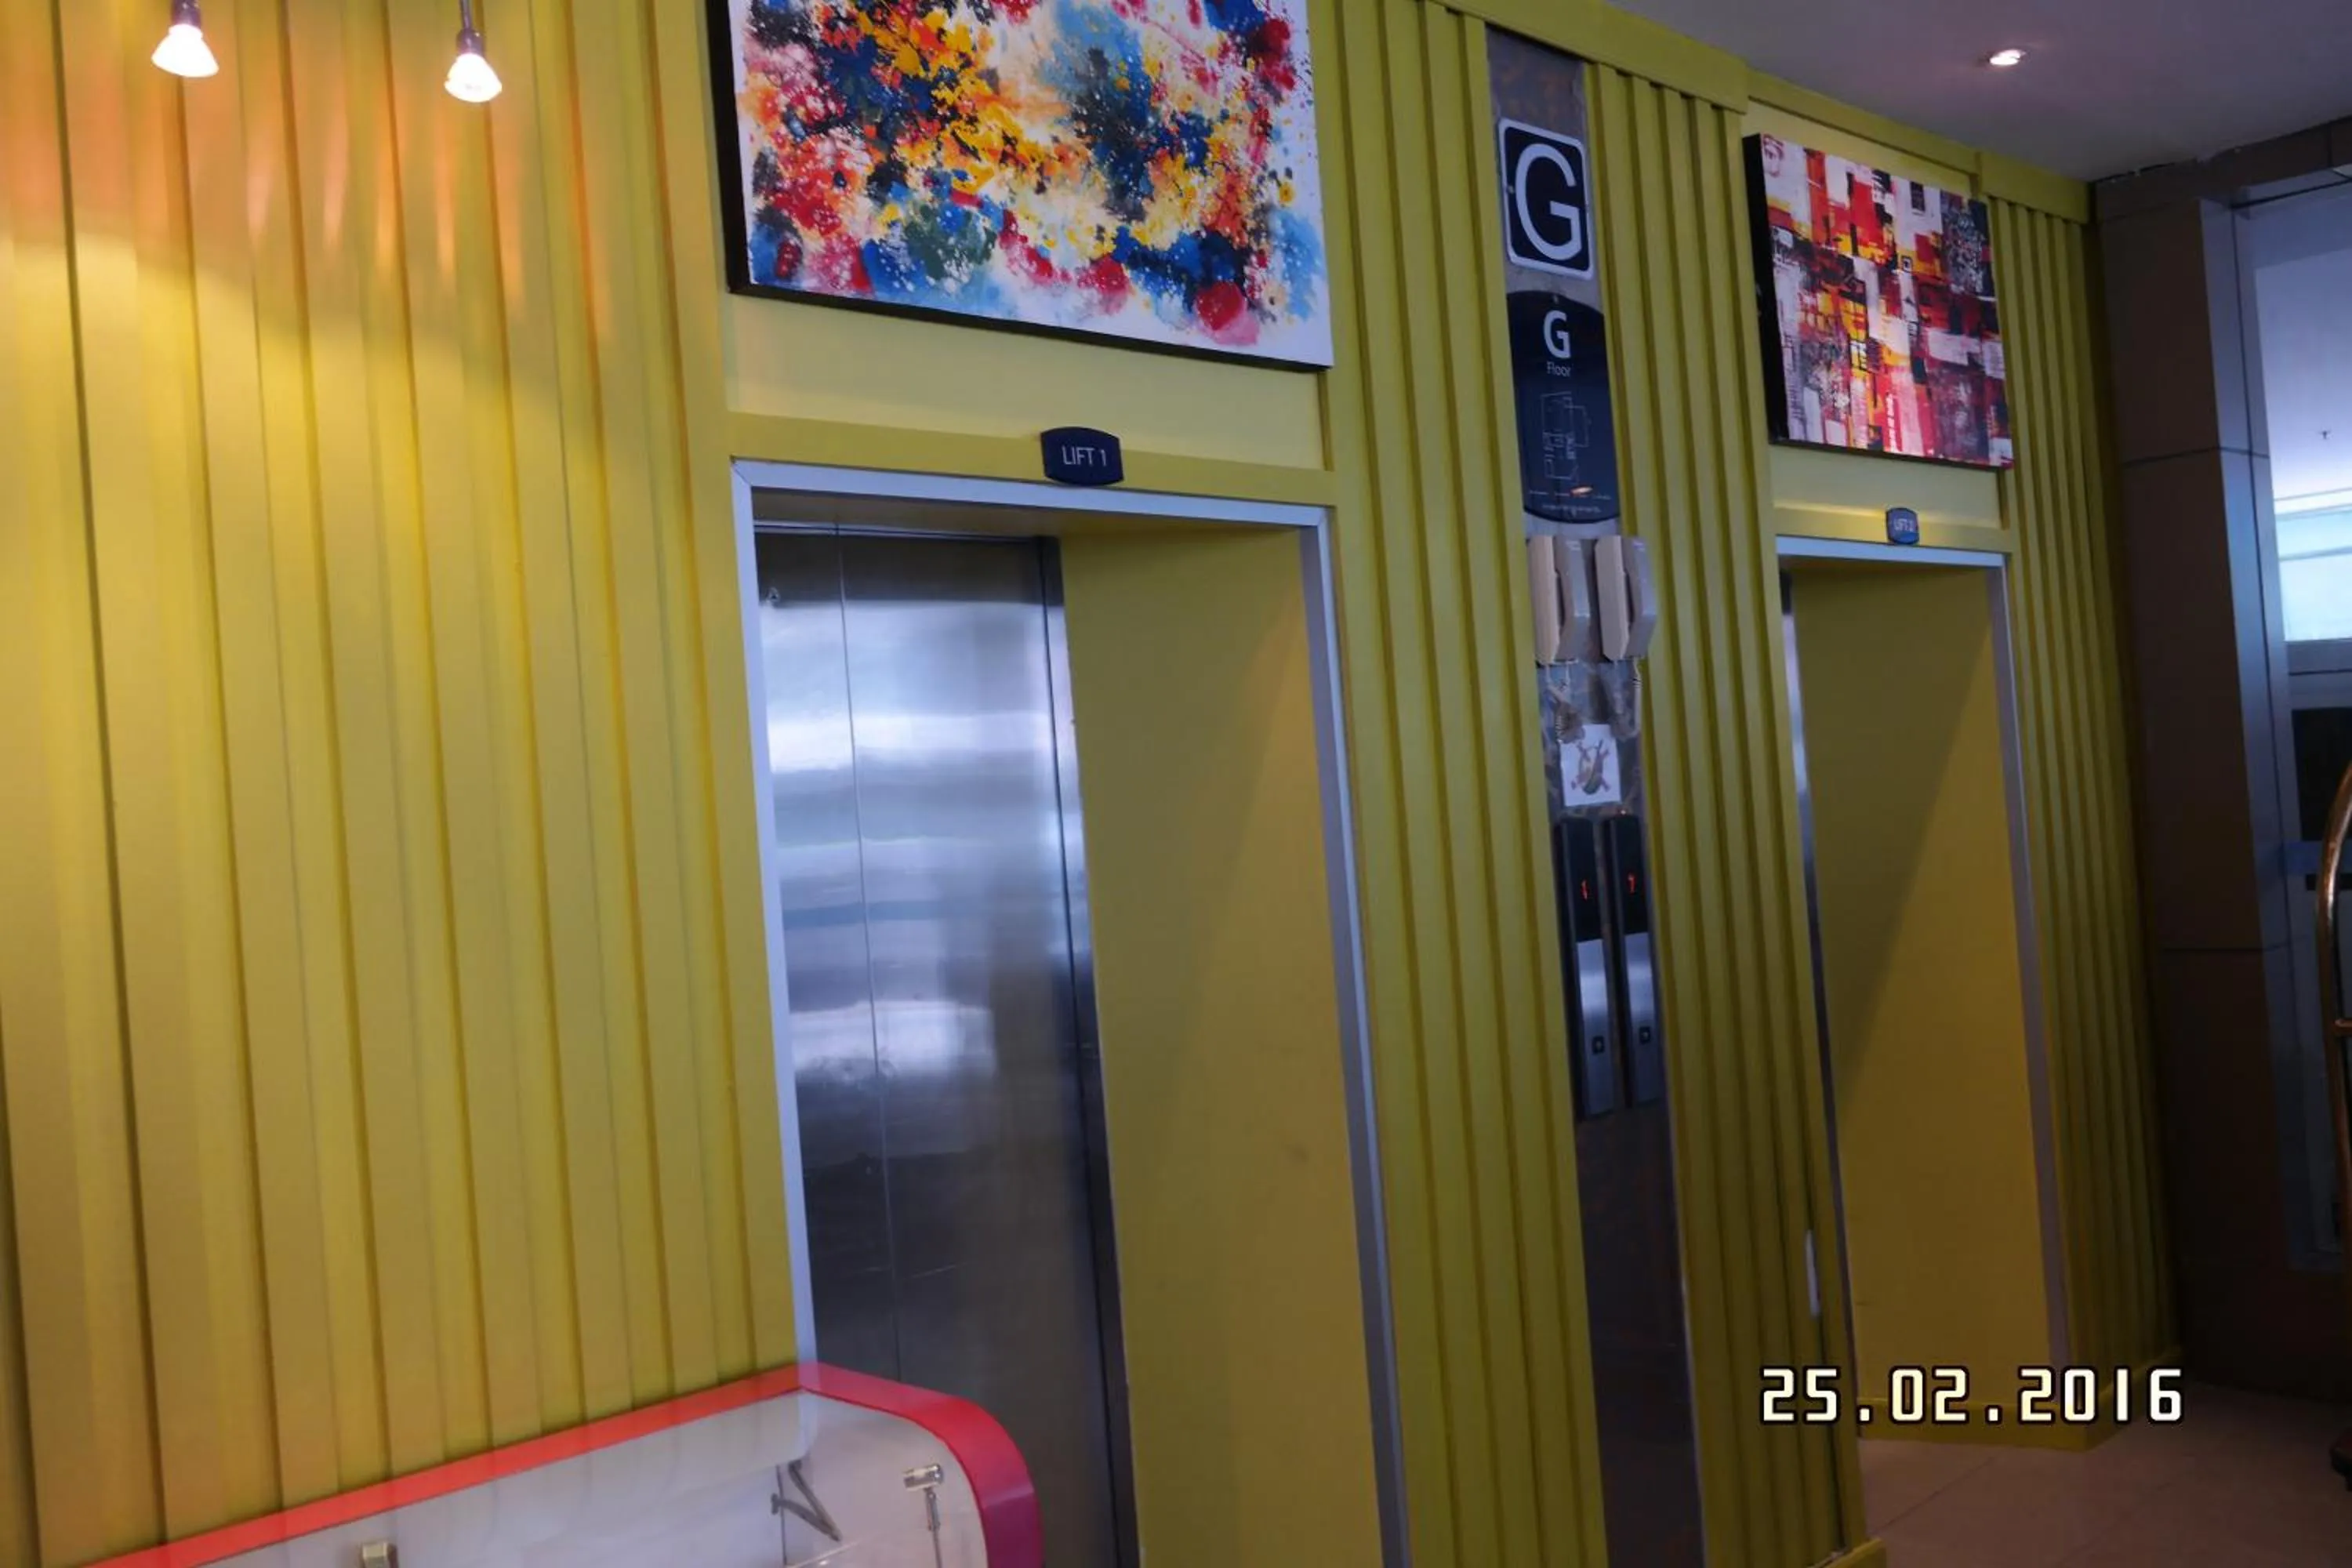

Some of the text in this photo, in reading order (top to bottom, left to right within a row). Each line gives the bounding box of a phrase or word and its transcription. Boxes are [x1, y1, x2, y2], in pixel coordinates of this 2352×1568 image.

[1515, 143, 1583, 261] G
[1543, 310, 1571, 358] G
[1547, 361, 1571, 377] Floor
[1062, 445, 1107, 466] LIFT 1
